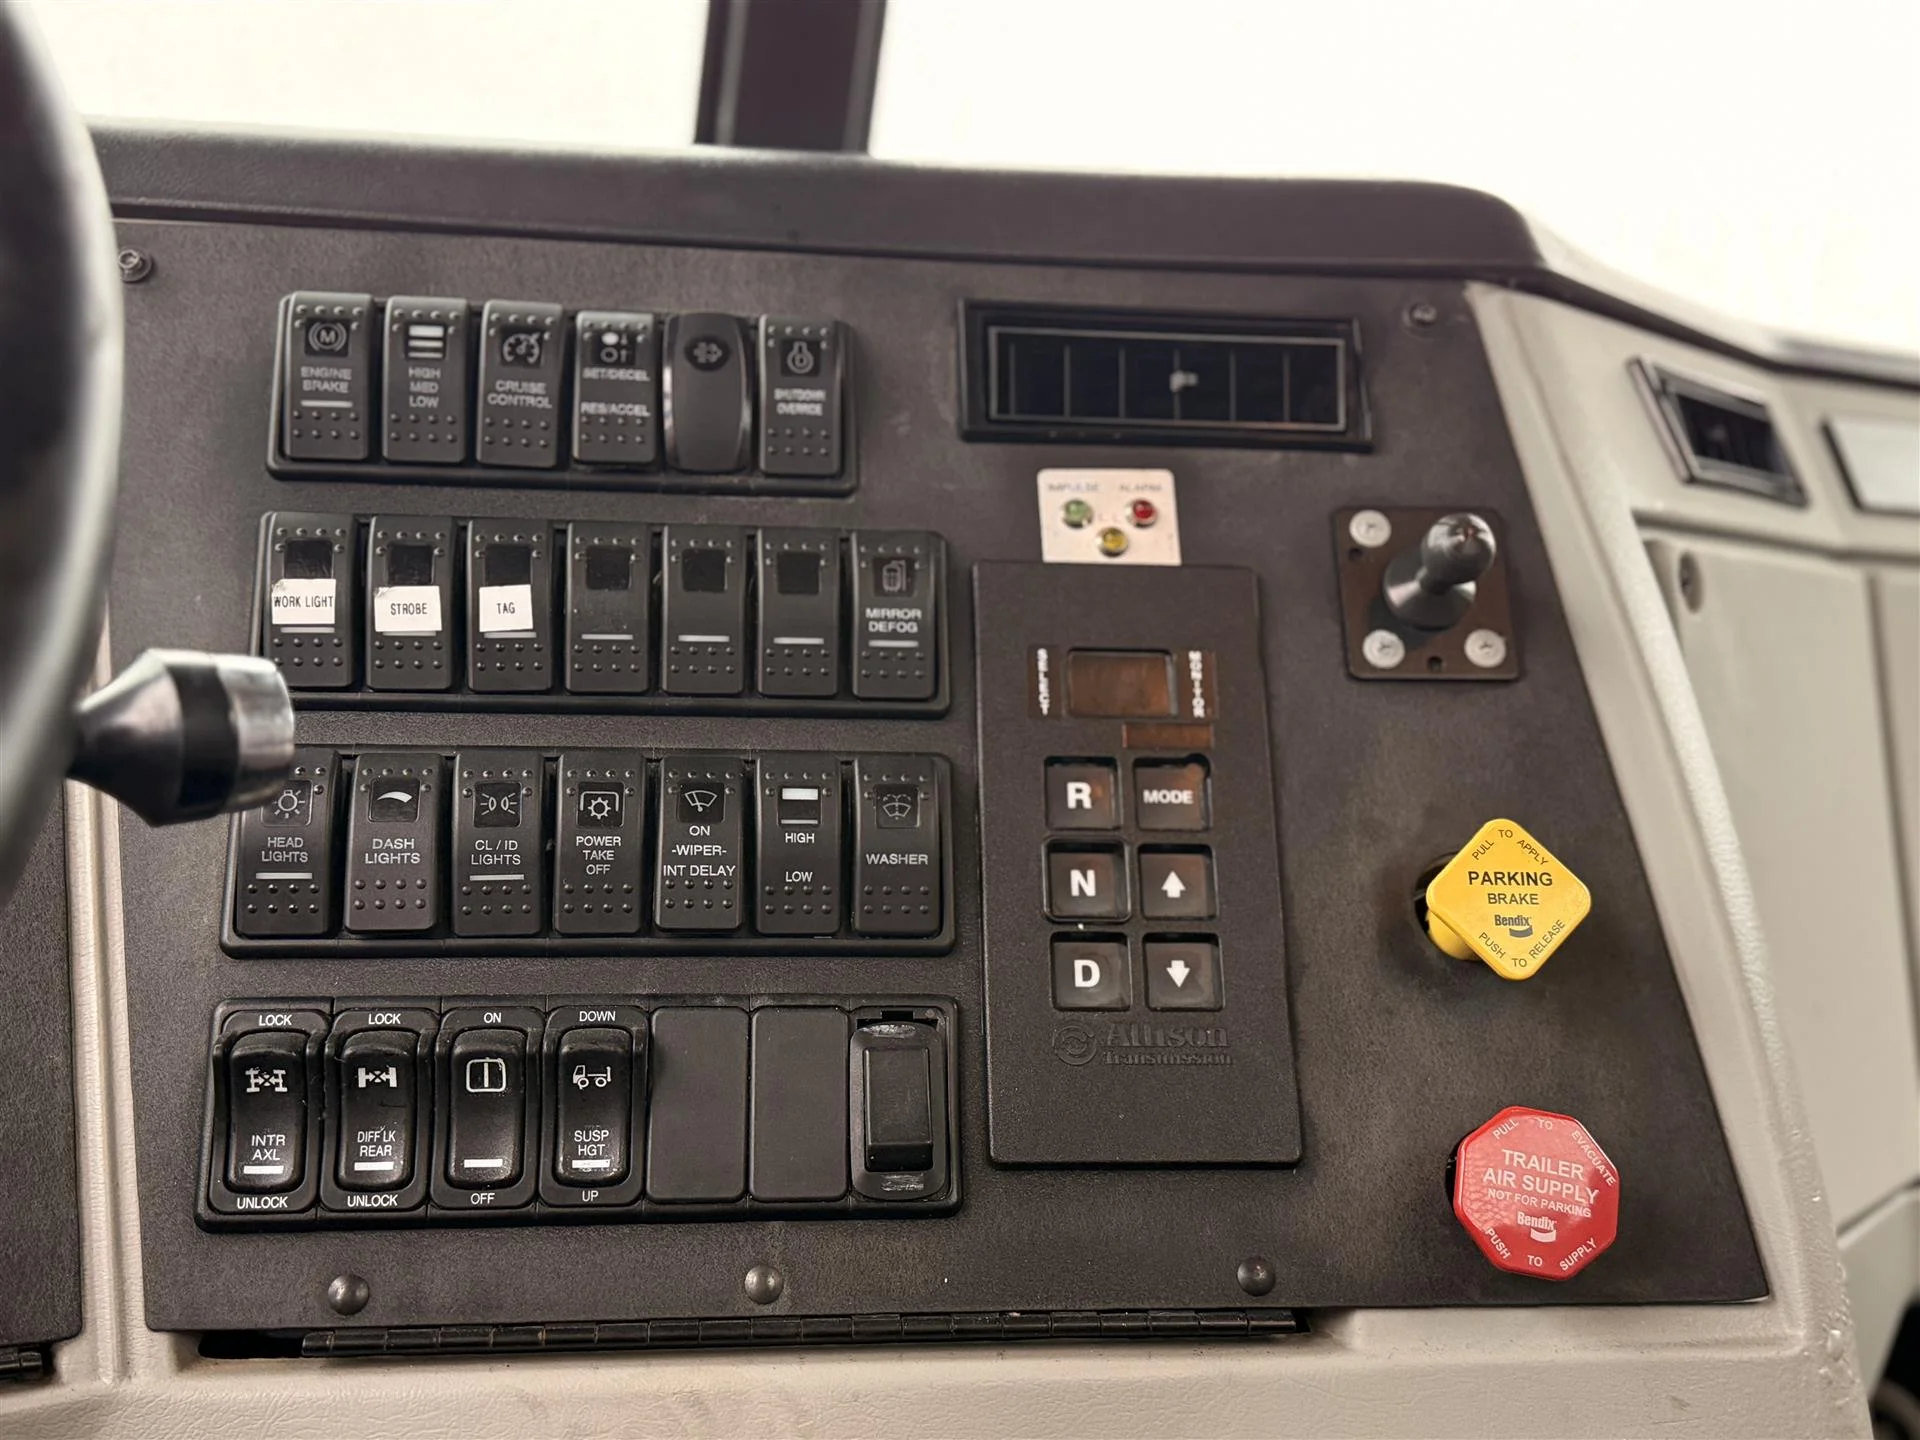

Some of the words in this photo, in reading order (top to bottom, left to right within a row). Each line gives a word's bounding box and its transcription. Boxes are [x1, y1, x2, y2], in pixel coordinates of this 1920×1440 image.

[301, 367, 352, 380] ENGINE
[408, 367, 441, 379] HIGH
[302, 380, 349, 393] BRAKE
[410, 381, 439, 393] MED
[495, 380, 547, 395] CRUISE
[409, 395, 439, 408] LOW
[487, 394, 553, 409] CONTROL
[273, 596, 301, 608] WORK
[305, 596, 333, 608] LIGHT
[390, 603, 428, 615] STROBE
[496, 603, 516, 614] TAG
[866, 608, 922, 621] MIRROR
[868, 620, 918, 634] DEFOG
[1066, 781, 1092, 809] R
[1143, 790, 1193, 805] MODE
[689, 826, 710, 836] ON
[267, 836, 304, 848] HEAD
[372, 838, 415, 850] DASH
[576, 836, 621, 847] POWER
[785, 833, 815, 843] HIGH
[475, 840, 493, 851] CL
[504, 840, 518, 851] ID
[672, 845, 727, 856] -WIPER-
[1472, 839, 1495, 861] PULL
[1498, 829, 1513, 838] TO
[1517, 839, 1549, 866] APPLY
[261, 851, 308, 863] LIGHTS
[365, 852, 421, 864] LIGHTS
[471, 854, 521, 866] LIGHTS
[582, 850, 614, 860] TAKE
[866, 853, 928, 865] WASHER
[586, 864, 611, 875] OFF
[663, 865, 686, 876] INT
[689, 865, 736, 876] DELAY
[785, 871, 813, 882] LOW
[1468, 871, 1553, 887] PARKING
[1070, 869, 1096, 897] N
[1487, 893, 1540, 905] BRAKE
[1494, 915, 1531, 927] Bendix
[1478, 932, 1506, 958] PUSH
[1512, 958, 1528, 968] TO
[1528, 919, 1565, 958] RELEASE
[1073, 959, 1100, 988] D
[259, 1014, 292, 1027] LOCK
[368, 1013, 401, 1025] LOCK
[483, 1012, 501, 1024] ON
[579, 1011, 616, 1022] DOWN
[251, 1134, 286, 1147] INTR
[357, 1131, 380, 1143] DIFF
[383, 1131, 396, 1142] LK
[574, 1130, 609, 1142] SUSP
[252, 1149, 280, 1161] AXL
[359, 1145, 392, 1157] REAR
[578, 1144, 606, 1156] HGT
[1492, 1119, 1519, 1140] PULL
[1536, 1118, 1553, 1130] TO
[1571, 1130, 1616, 1186] EVACUATE
[1502, 1149, 1584, 1181] TRAILER
[1483, 1168, 1517, 1188] AIR
[1522, 1175, 1600, 1205] SUPPLY
[347, 1194, 398, 1208] UNLOCK
[470, 1193, 495, 1205] OFF
[582, 1190, 598, 1202] UP
[237, 1196, 288, 1209] UNLOCK
[1488, 1188, 1512, 1200] NOT
[1515, 1193, 1538, 1208] FOR
[1540, 1199, 1592, 1218] PARKING
[1517, 1211, 1556, 1230] Bendix
[1485, 1227, 1512, 1259] PUSH
[1528, 1255, 1543, 1267] TO
[1559, 1238, 1597, 1271] SUPPLY
